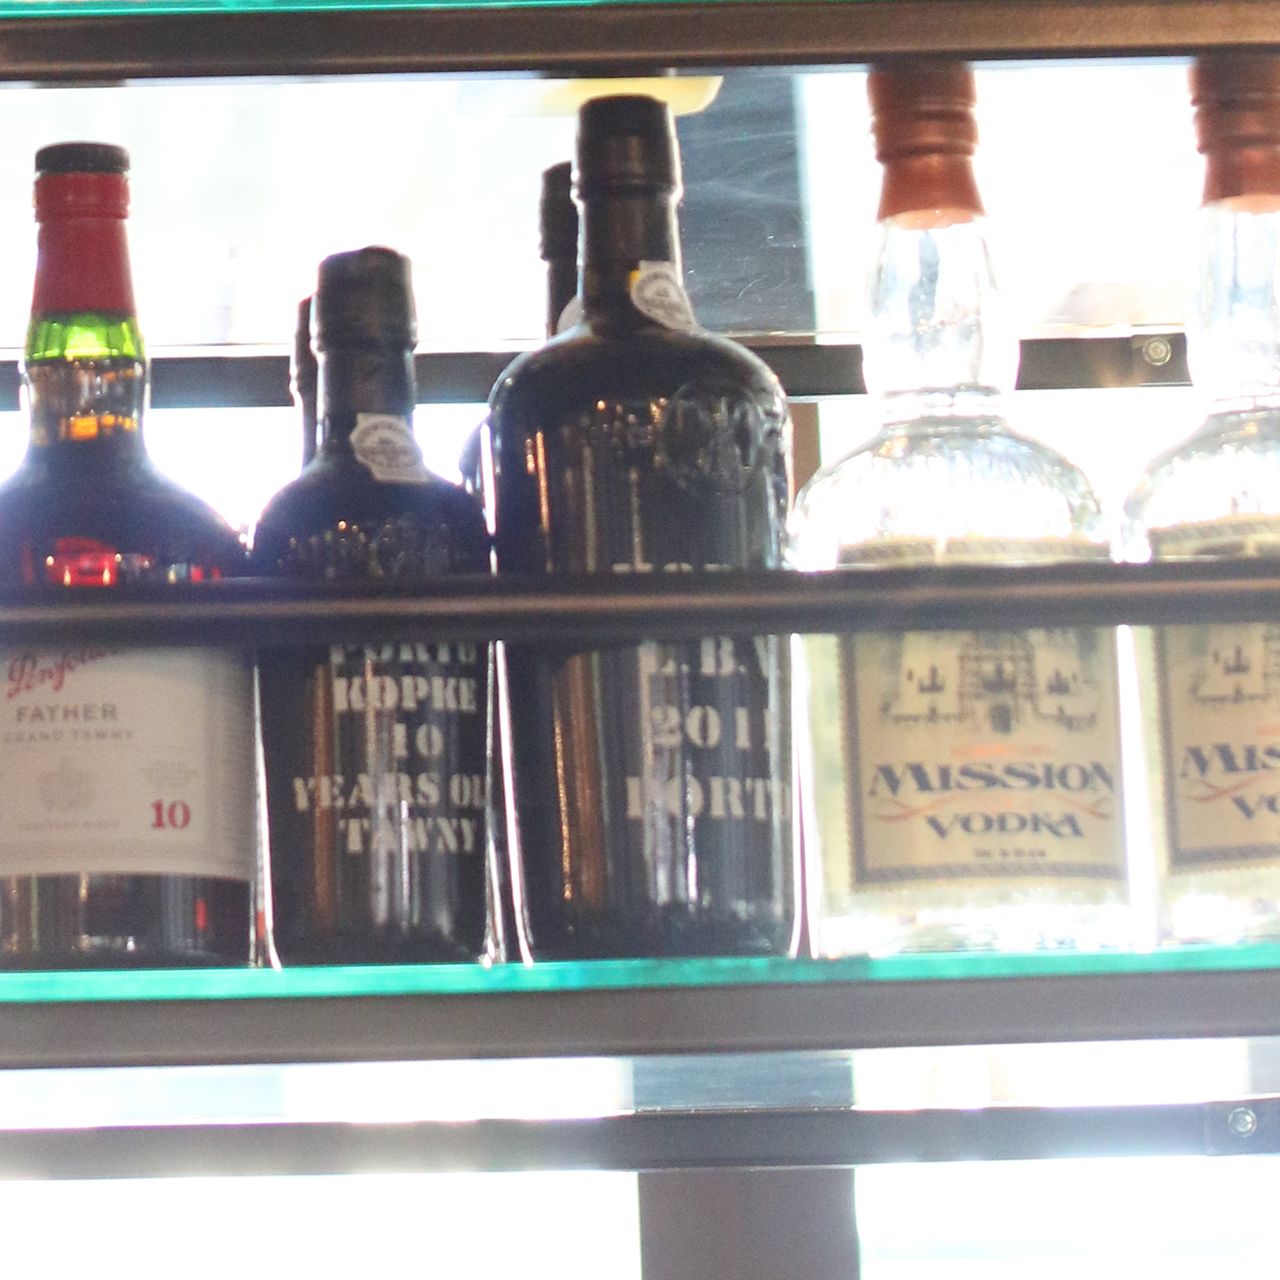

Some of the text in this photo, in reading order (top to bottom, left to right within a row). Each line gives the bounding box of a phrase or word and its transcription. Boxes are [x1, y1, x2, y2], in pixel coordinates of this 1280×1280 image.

[17, 702, 120, 724] FATHER
[333, 675, 477, 714] KOPKE
[292, 772, 441, 814] YEARS
[868, 760, 1115, 797] MISSION
[151, 799, 191, 830] 10
[925, 811, 1084, 840] VODKA
[339, 815, 478, 855] TAWNY
